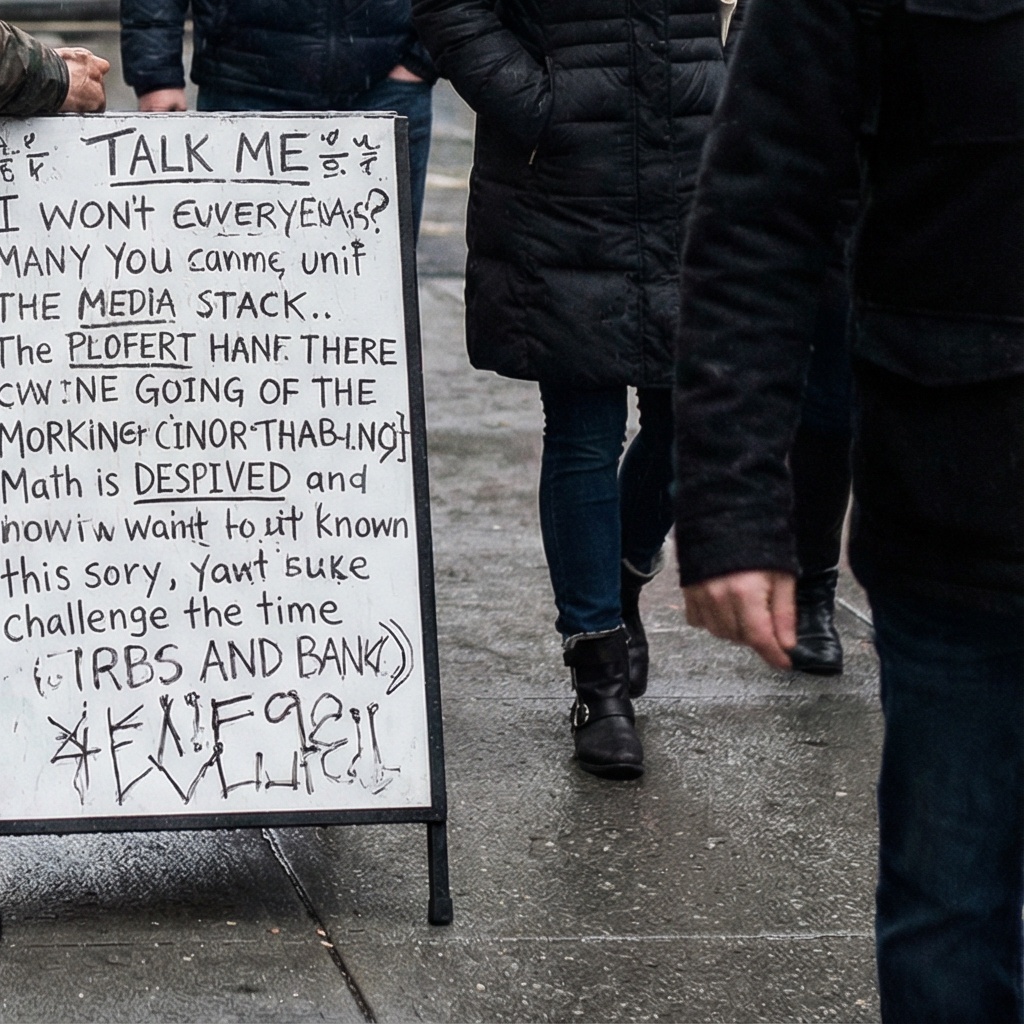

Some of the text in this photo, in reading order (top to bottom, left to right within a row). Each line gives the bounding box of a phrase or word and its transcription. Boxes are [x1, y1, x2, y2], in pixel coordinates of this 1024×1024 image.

[80, 127, 214, 176] TALK
[235, 131, 310, 177] ME
[105, 241, 173, 280] YOU
[65, 331, 197, 362] PLOFERT
[300, 334, 398, 366] THERE
[135, 373, 244, 408] GOING
[259, 378, 300, 406] OF
[311, 375, 377, 409] THE
[1, 459, 367, 505] Math is DESPIVED and
[316, 502, 408, 539] known
[0, 555, 71, 598] this
[84, 561, 177, 599] sory,
[4, 595, 343, 643] challenge the time
[199, 637, 283, 682] AND
